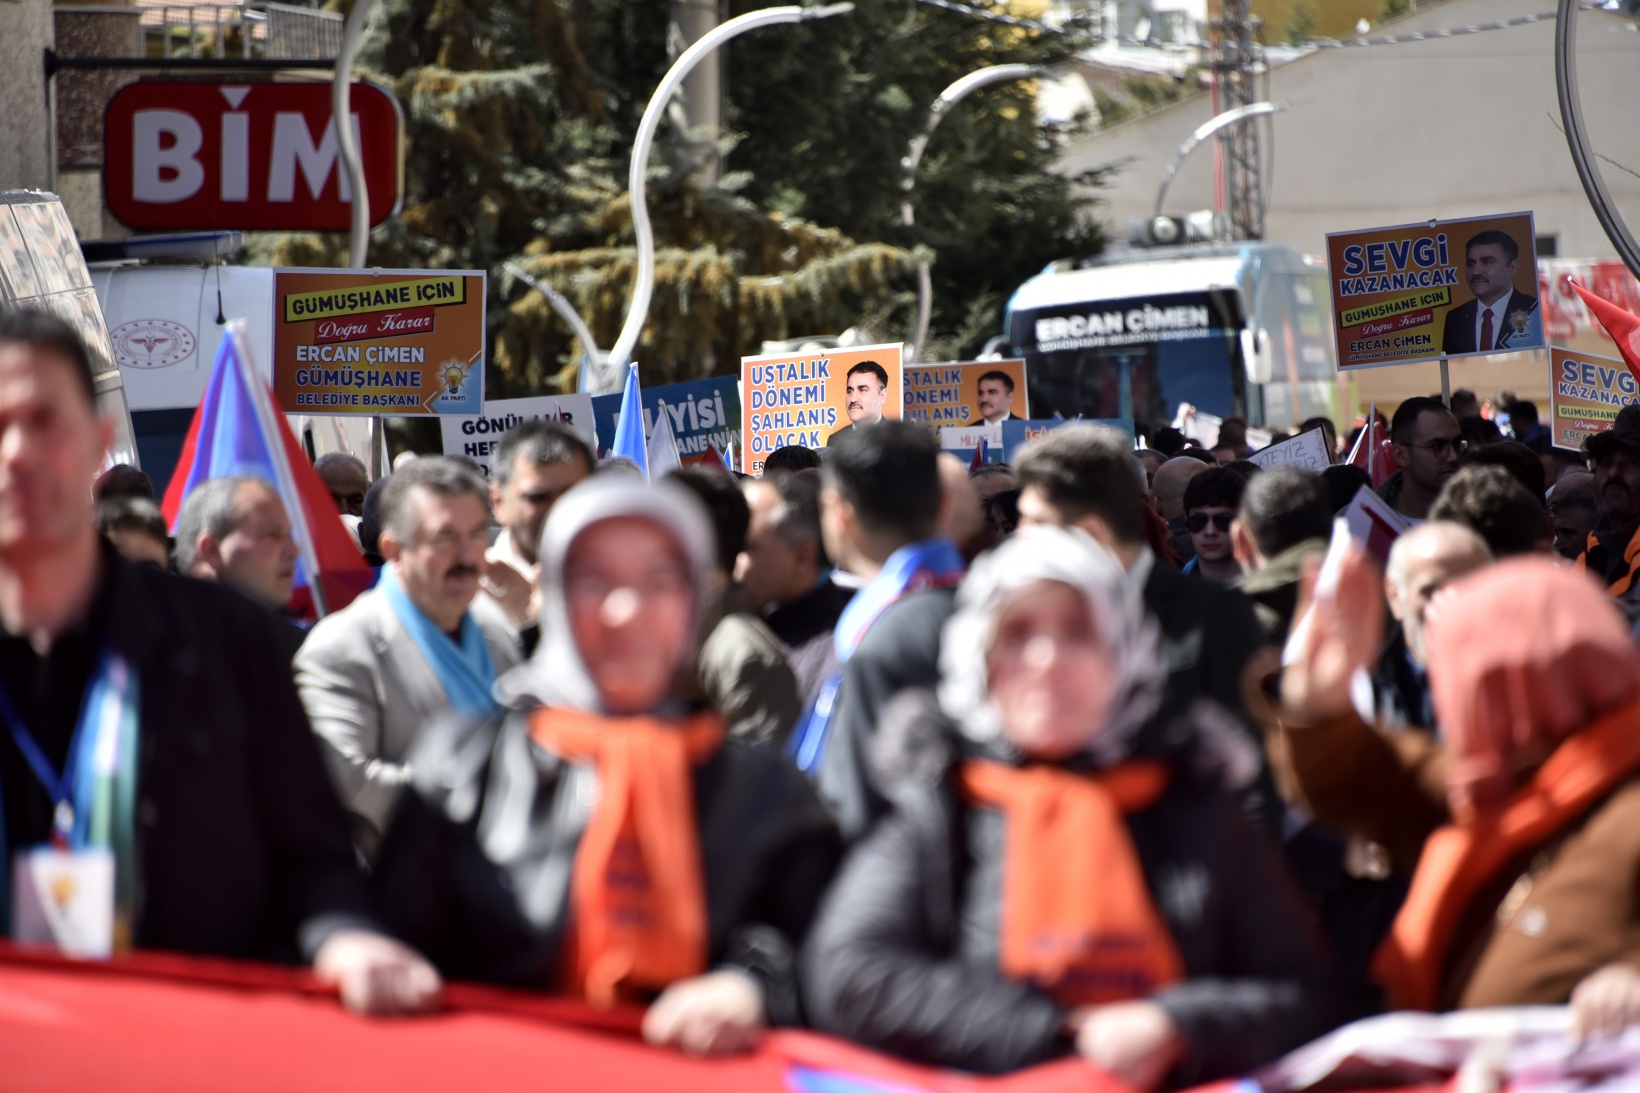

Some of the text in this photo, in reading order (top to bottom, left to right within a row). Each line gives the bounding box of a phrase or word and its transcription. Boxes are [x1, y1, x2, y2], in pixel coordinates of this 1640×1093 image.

[132, 86, 362, 203] BİM
[1343, 233, 1449, 276] SEVGİ
[416, 281, 456, 301] İÇİN
[1340, 267, 1459, 296] KAZANACAK
[1420, 291, 1444, 305] İÇİN
[317, 312, 431, 341] Doğru Karar
[1035, 304, 1209, 341] ERCAN ÇİMEN
[1399, 313, 1431, 327] Karar
[296, 345, 425, 365] ERCAN ÇİMEN
[1350, 334, 1431, 352] ERCAN ÇİMEN
[295, 365, 422, 389] GÜMÜŞHANE
[751, 359, 831, 385] USTALIK
[903, 369, 962, 386] STALIK
[297, 392, 420, 407] BELEDİYE BAŞKANI
[751, 380, 826, 409] DÖNEMİ
[903, 385, 959, 405] ÖNEMİ
[1559, 382, 1640, 407] KAZANACA
[751, 407, 837, 434] ŞAHLANIŞ
[751, 430, 820, 454] OLACAK
